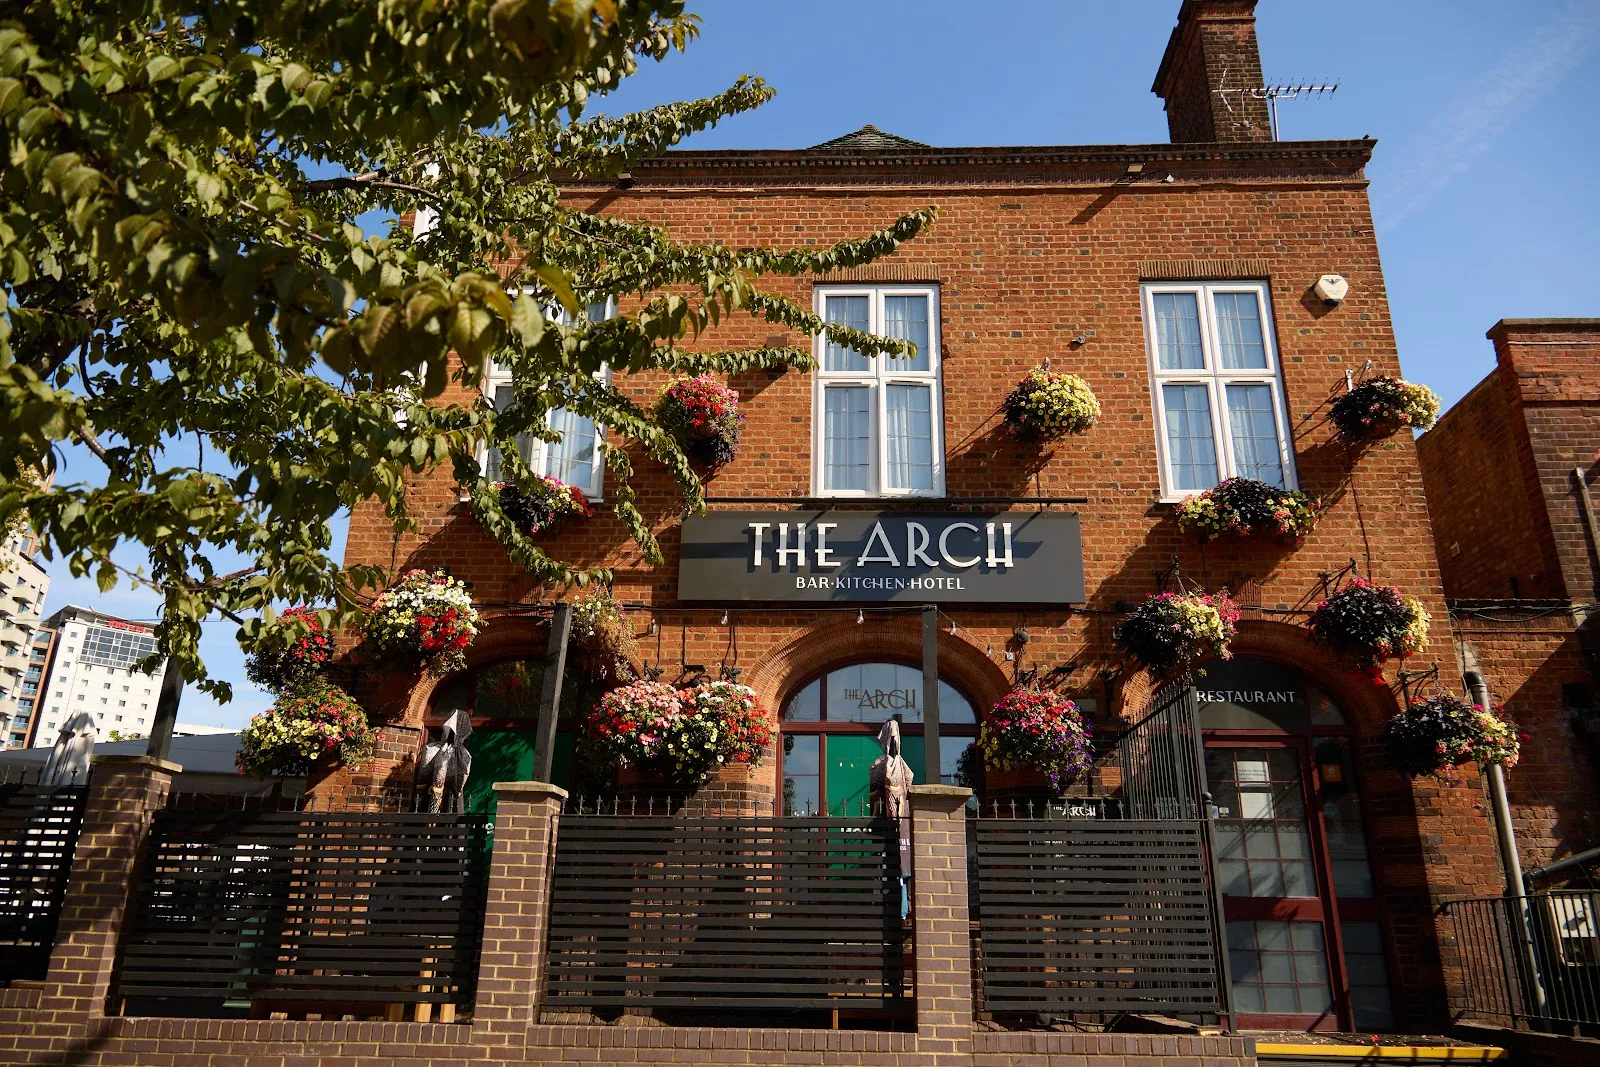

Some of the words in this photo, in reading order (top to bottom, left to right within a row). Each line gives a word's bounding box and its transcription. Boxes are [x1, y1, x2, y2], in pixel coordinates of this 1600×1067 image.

[749, 522, 841, 567] THE
[857, 520, 1013, 568] ARCH
[844, 689, 860, 700] THE
[858, 689, 915, 708] ARCH
[1197, 690, 1295, 703] RESTAURANT
